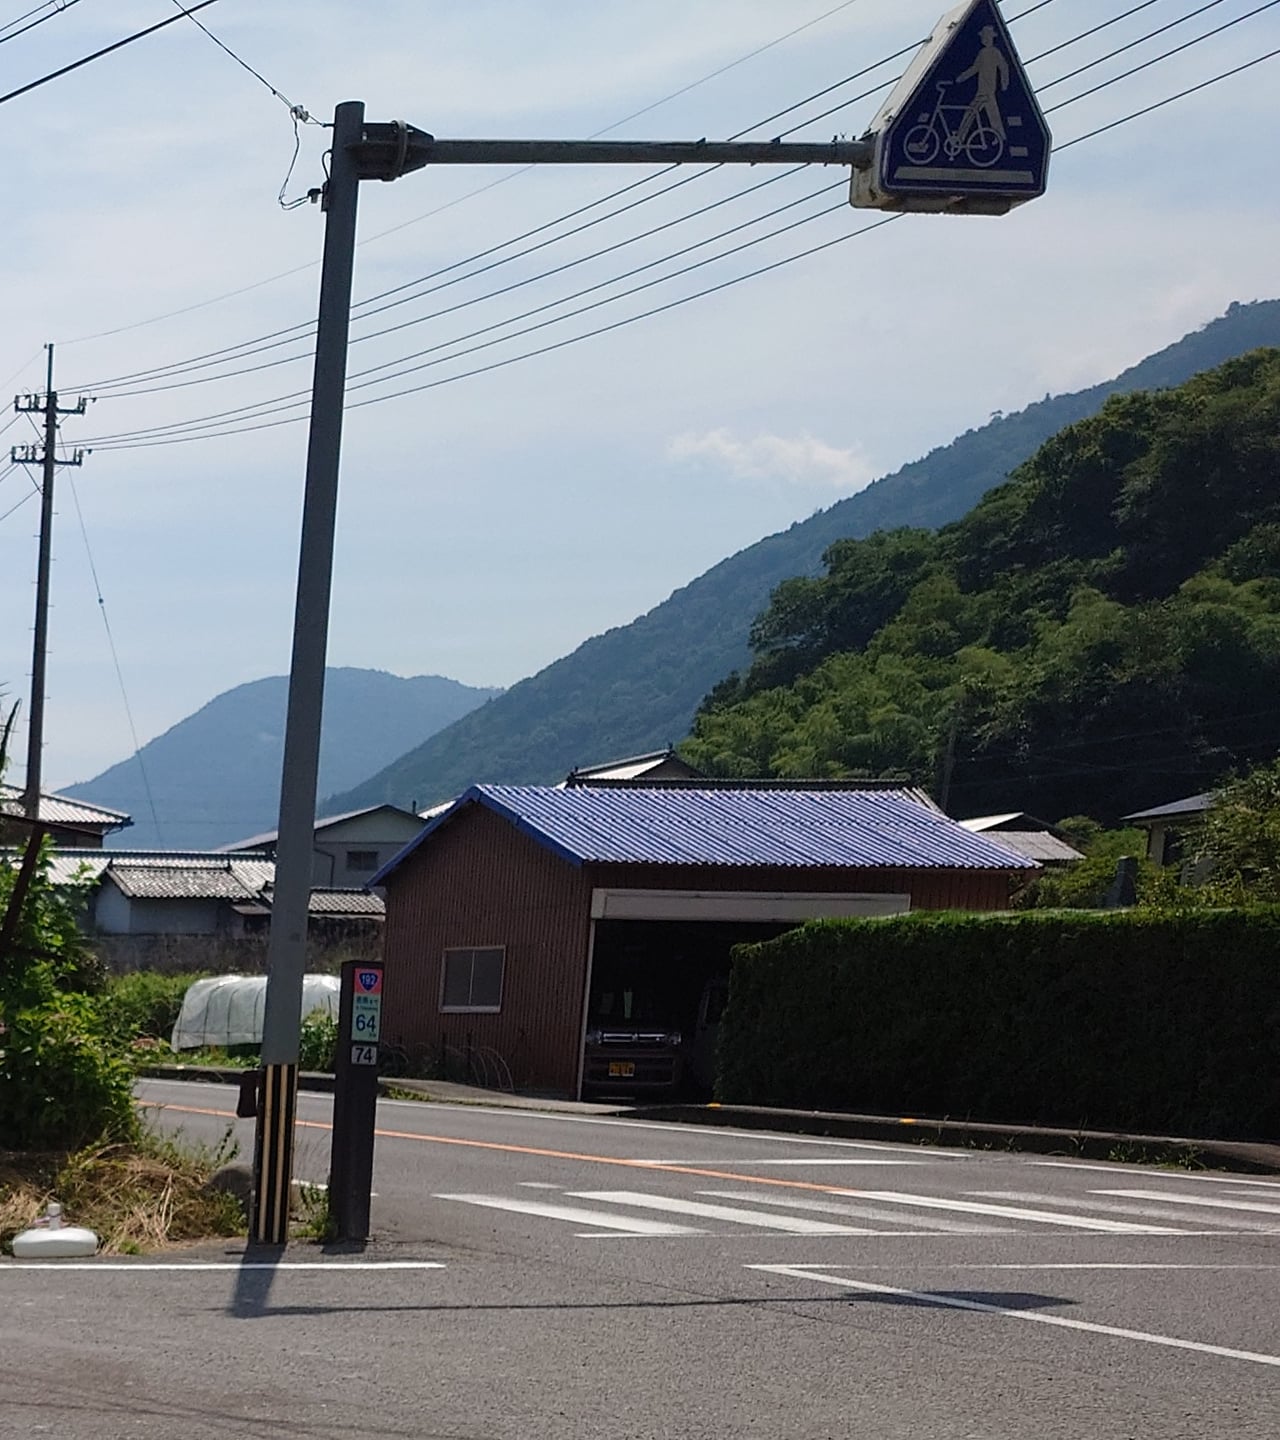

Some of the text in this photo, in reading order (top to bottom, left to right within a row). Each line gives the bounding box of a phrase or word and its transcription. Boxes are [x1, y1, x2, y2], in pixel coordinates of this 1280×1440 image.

[361, 974, 376, 985] 192
[355, 1013, 377, 1032] 64
[355, 1047, 373, 1063] 74
